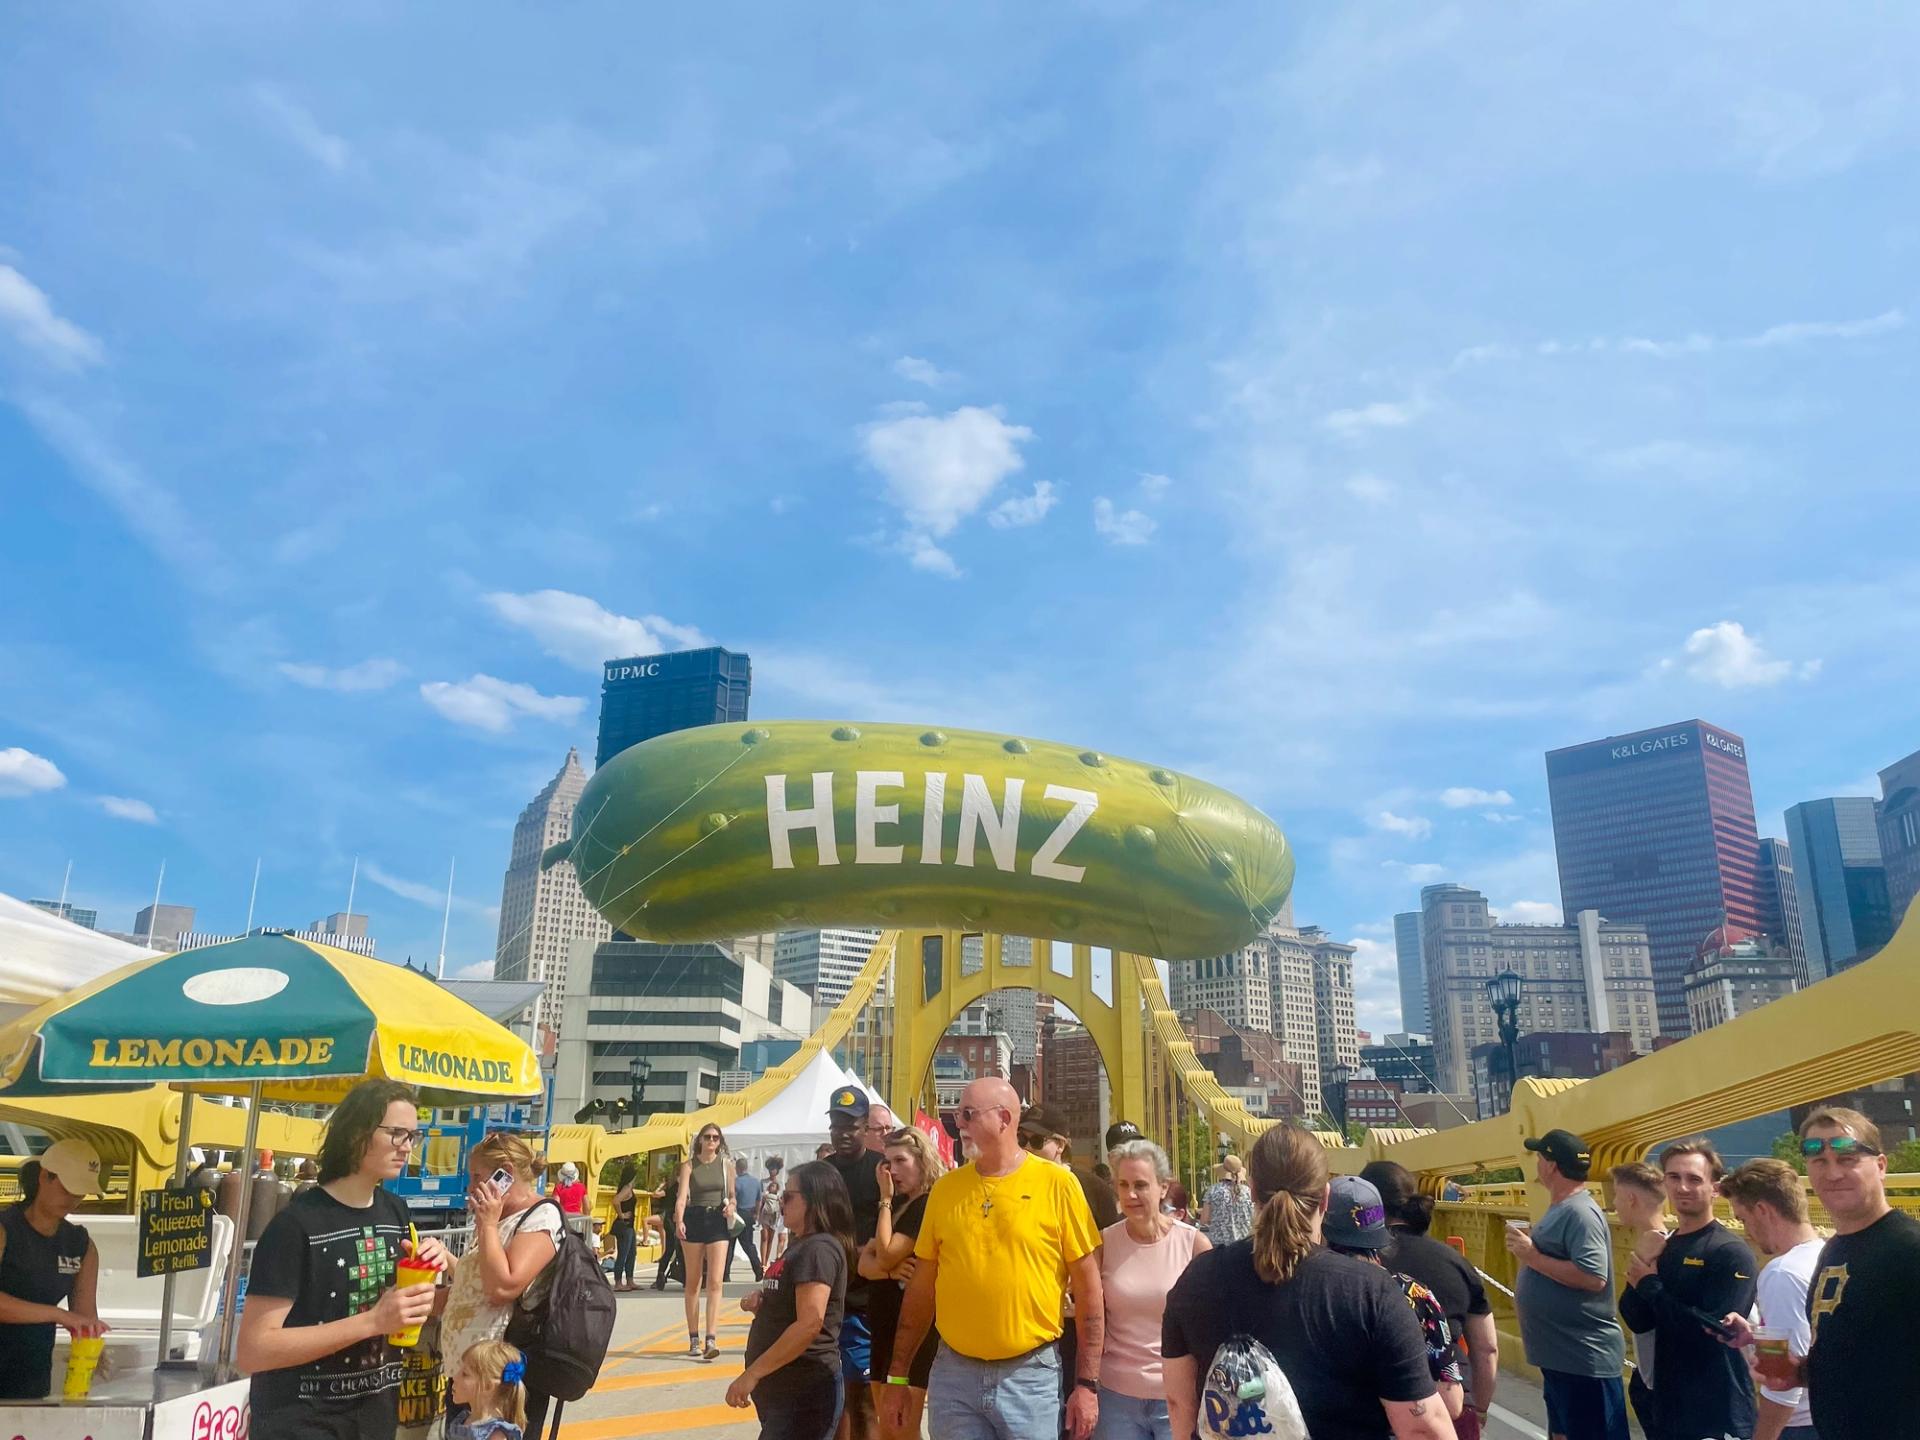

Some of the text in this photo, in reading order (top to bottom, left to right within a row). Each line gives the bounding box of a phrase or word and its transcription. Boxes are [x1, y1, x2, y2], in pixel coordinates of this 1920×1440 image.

[606, 662, 661, 682] UPMC
[1611, 733, 1689, 760] K&L GATES
[1705, 733, 1721, 749] K&L
[764, 770, 1099, 883] HEINZ
[88, 1037, 336, 1068] LEMONADE
[398, 1043, 514, 1084] LEMONADE
[161, 1192, 194, 1212] Fresh
[149, 1208, 206, 1236] Squeezed
[145, 1231, 208, 1257] Lemonade
[172, 1253, 199, 1269] Refills
[300, 1367, 403, 1394] OH CHEMISTREE
[1204, 1390, 1272, 1437] Pitt
